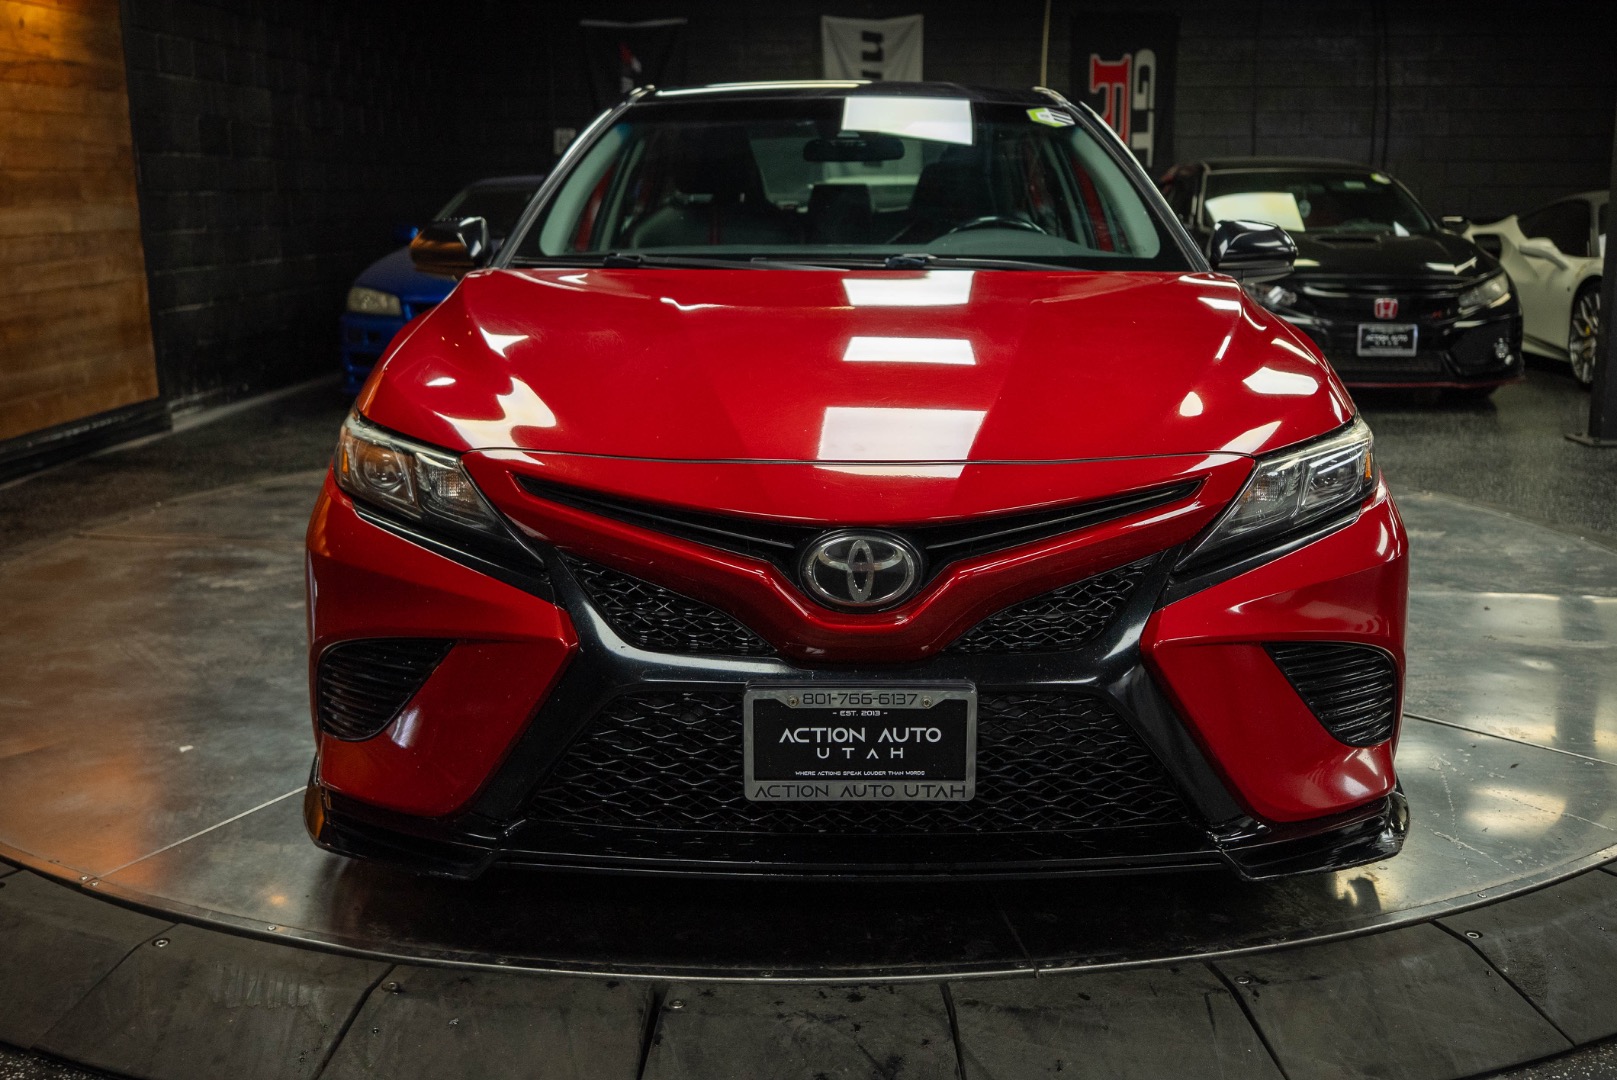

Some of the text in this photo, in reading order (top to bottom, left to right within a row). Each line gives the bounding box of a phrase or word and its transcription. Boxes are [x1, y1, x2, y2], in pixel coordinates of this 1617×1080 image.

[1132, 49, 1156, 168] GT
[803, 693, 918, 705] 801-766-6137
[779, 727, 942, 743] ACTION AUTO
[755, 785, 966, 798] ACTION AUTO UTAH
